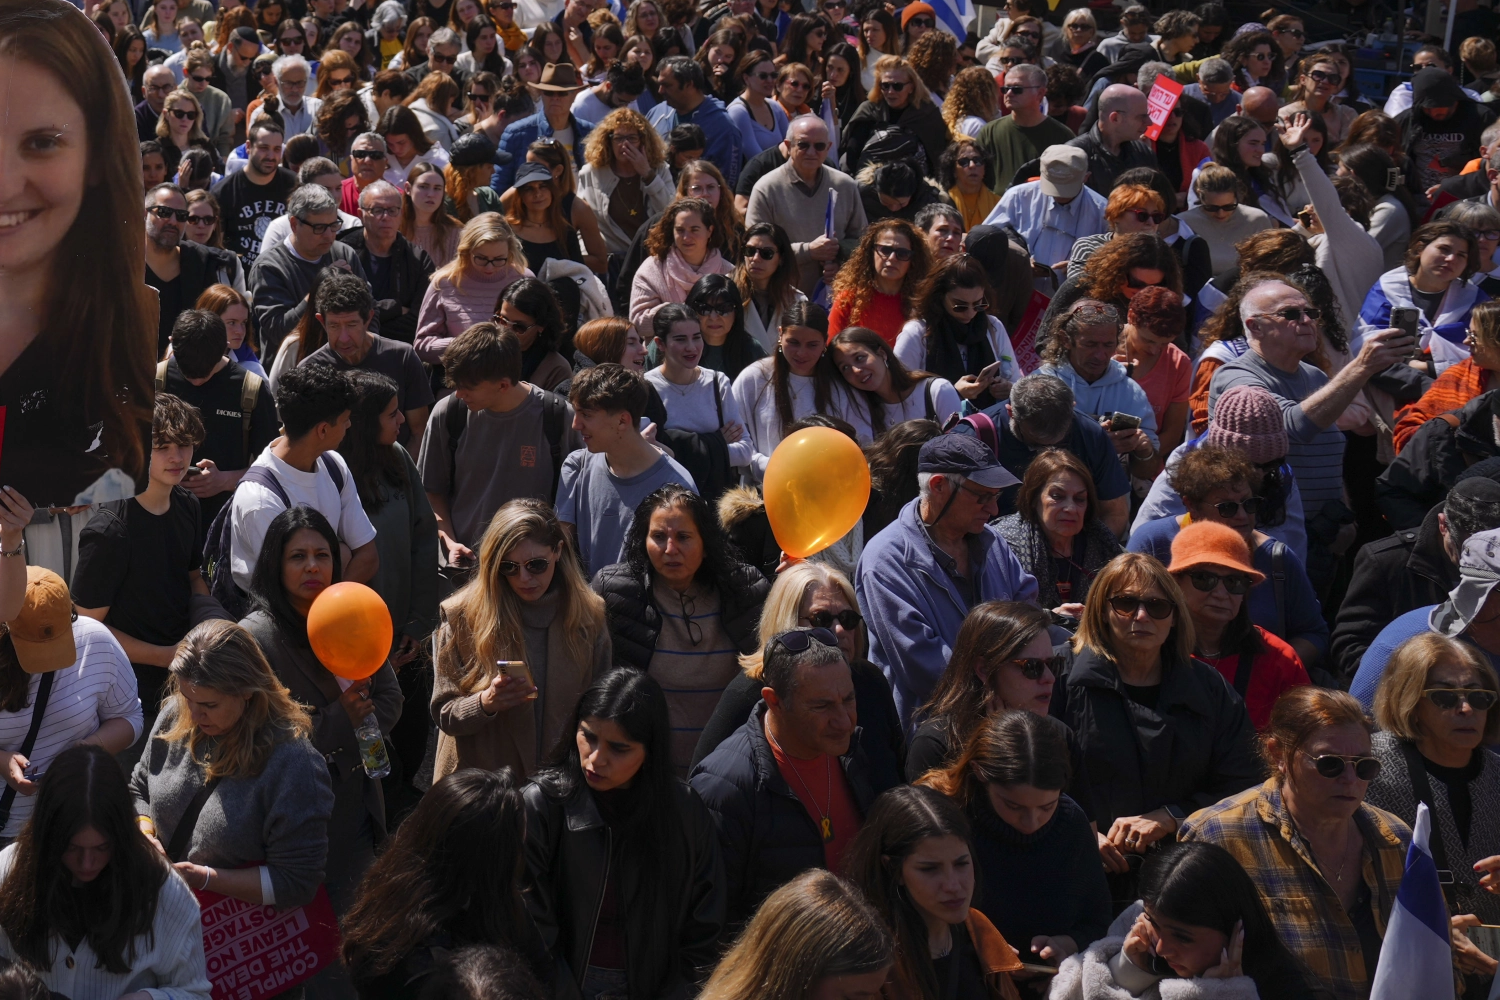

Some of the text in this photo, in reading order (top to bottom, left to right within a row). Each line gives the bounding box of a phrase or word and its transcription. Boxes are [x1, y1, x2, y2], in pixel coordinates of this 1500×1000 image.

[242, 200, 286, 218] BEER
[216, 409, 242, 418] DICKIES
[203, 905, 284, 953] OSTAGE
[207, 915, 300, 974] LEAVE NO
[215, 937, 310, 994] THE DEAL
